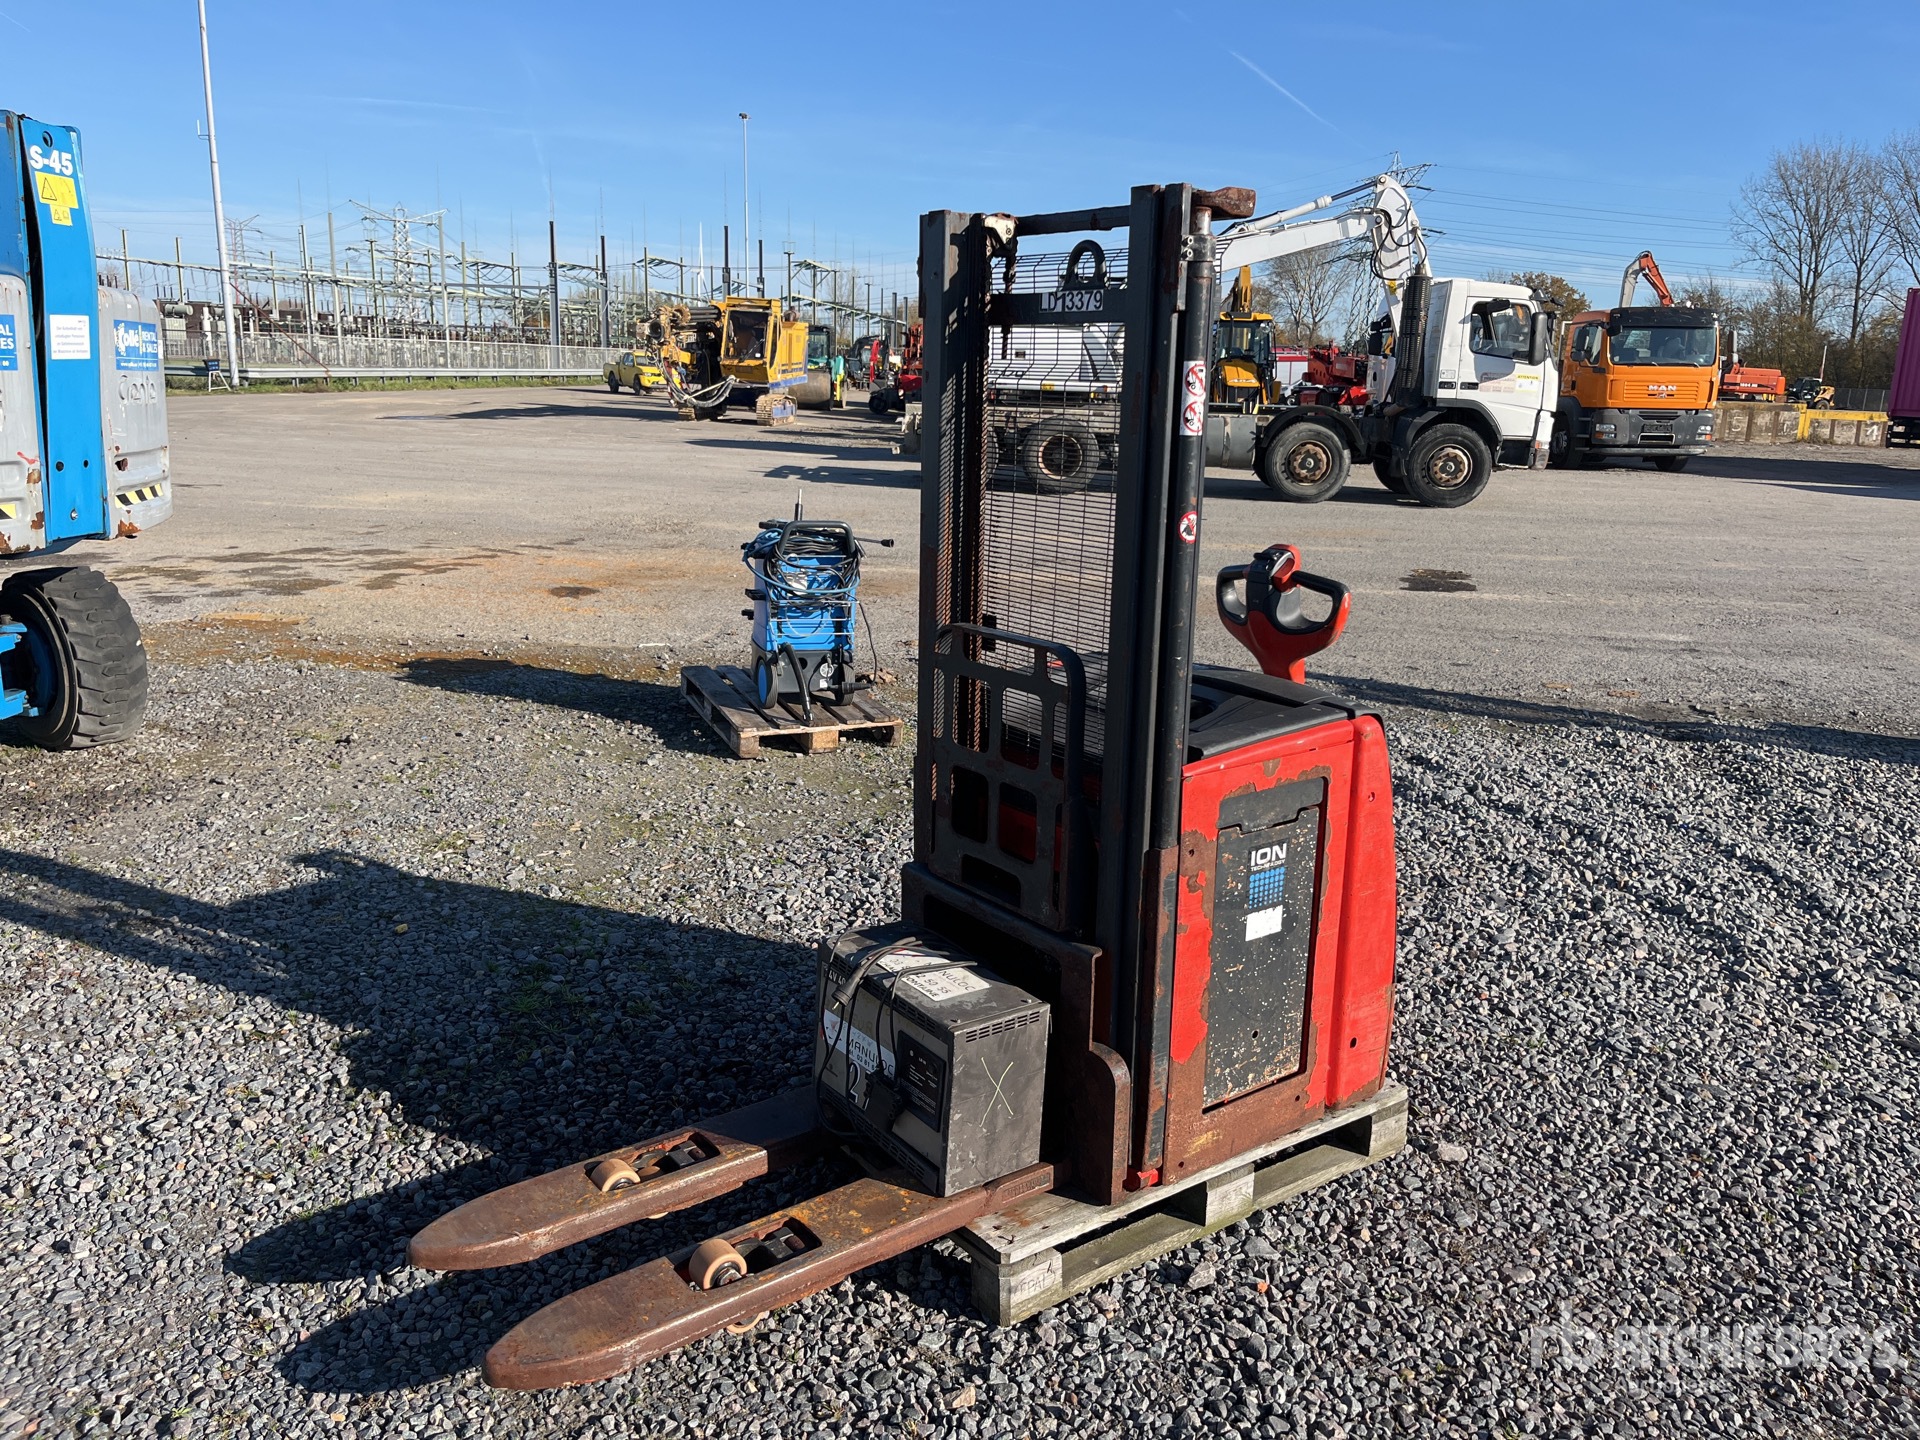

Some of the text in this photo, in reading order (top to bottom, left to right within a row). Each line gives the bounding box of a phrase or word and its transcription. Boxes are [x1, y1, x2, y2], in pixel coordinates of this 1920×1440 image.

[29, 145, 73, 177] S-45
[1041, 289, 1104, 312] LD13379
[1251, 843, 1287, 866] ION
